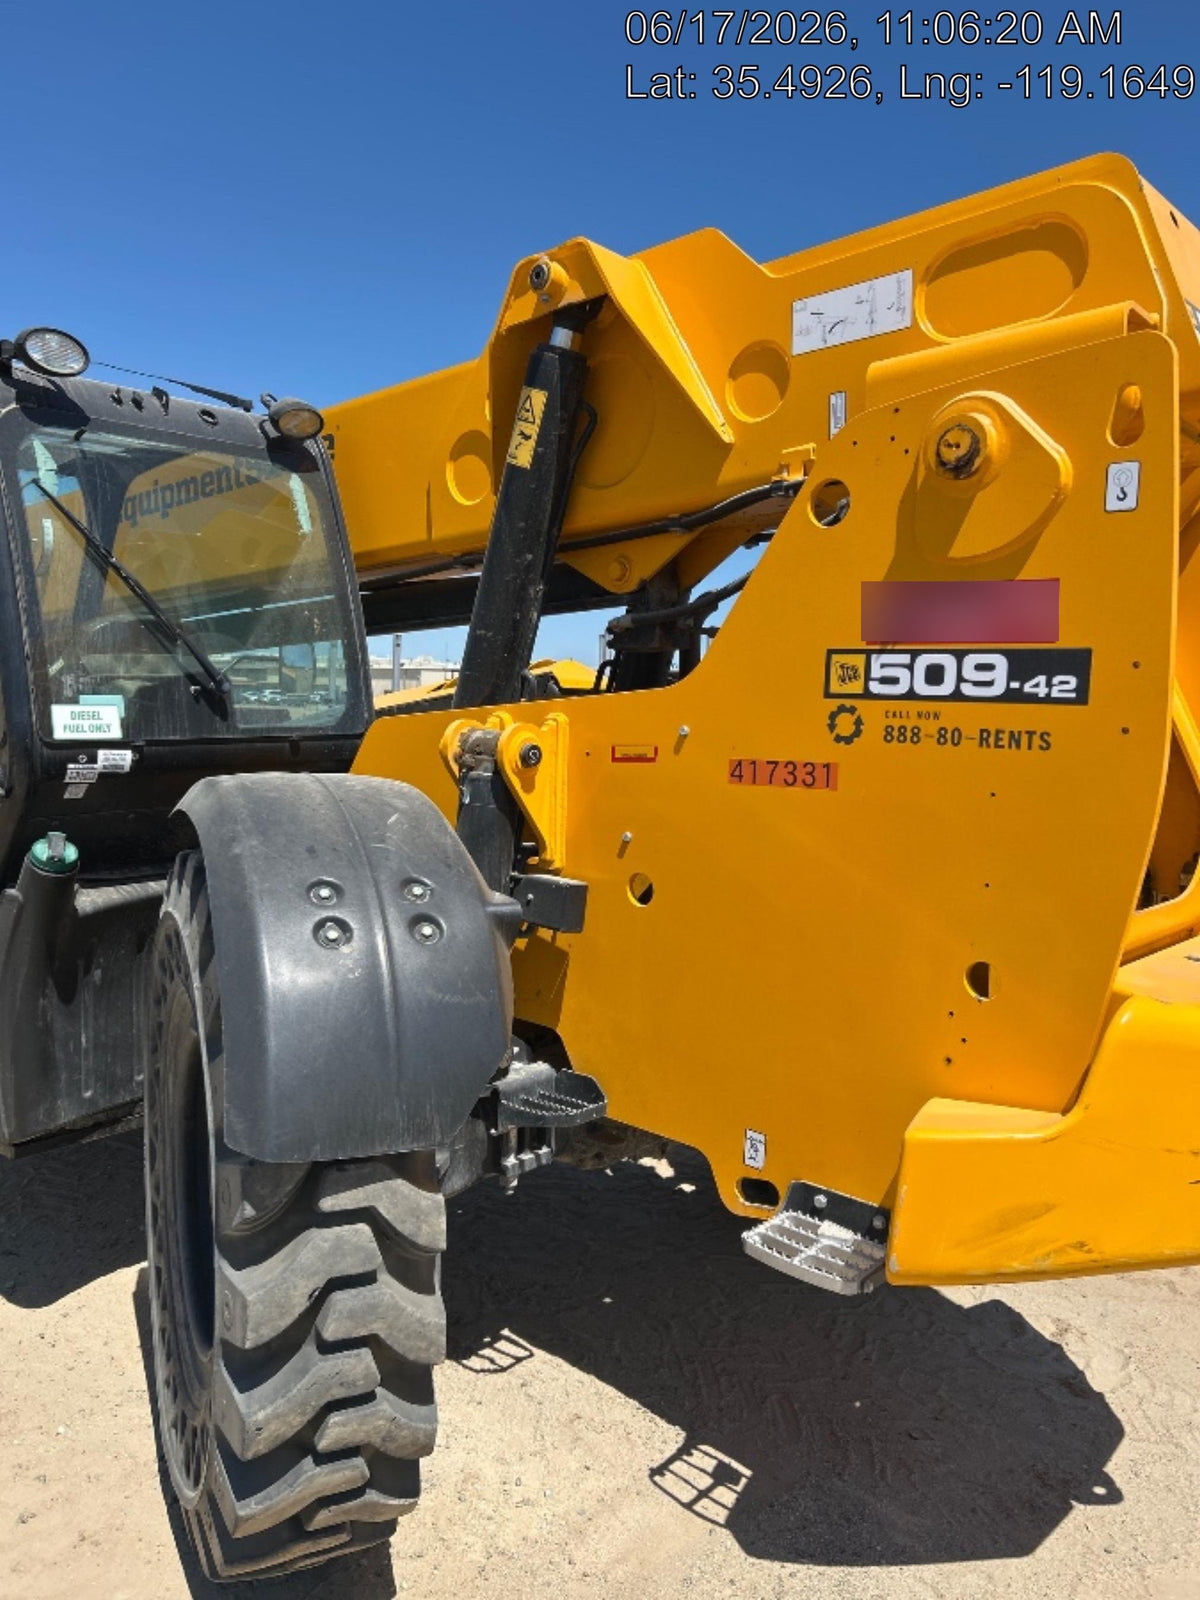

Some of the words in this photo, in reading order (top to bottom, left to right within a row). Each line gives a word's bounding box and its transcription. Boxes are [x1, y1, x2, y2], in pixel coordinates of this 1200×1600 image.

[120, 456, 259, 528] quipment
[868, 653, 1078, 698] 509-42
[63, 723, 88, 734] FUEL
[88, 723, 112, 734] ONLY
[70, 710, 104, 721] DIESEL
[884, 710, 910, 720] CALL
[916, 711, 941, 721] NOW
[882, 724, 1052, 751] 888-80-RENTS
[730, 759, 831, 788] 417331
